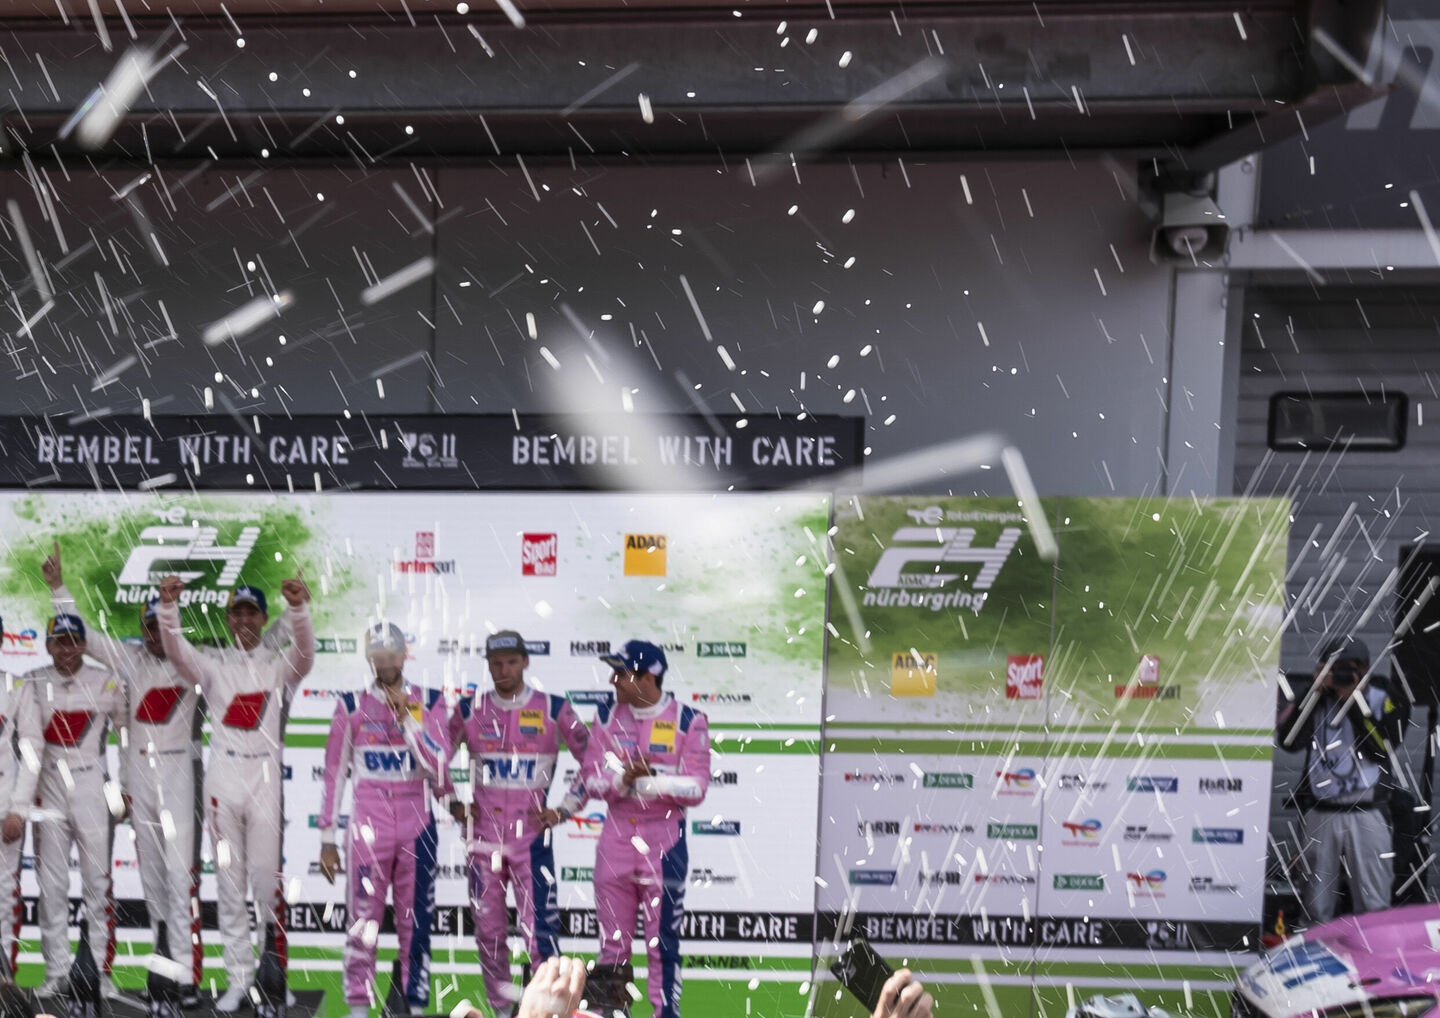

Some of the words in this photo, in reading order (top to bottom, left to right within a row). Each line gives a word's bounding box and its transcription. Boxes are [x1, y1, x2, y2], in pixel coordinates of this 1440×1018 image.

[38, 435, 160, 464] BEMBEL
[179, 435, 251, 464] WITH
[269, 435, 350, 465] CARE
[512, 435, 637, 465] BEMBEL
[660, 435, 733, 465] WITH
[751, 435, 836, 466] CARE
[626, 535, 666, 550] ADAC
[115, 586, 230, 608] nürbgring
[863, 588, 984, 611] nürburgring
[738, 916, 798, 940] CARE
[867, 916, 958, 942] BEMBEL
[972, 918, 1031, 943] WITH
[1042, 922, 1104, 944] CARE
[686, 954, 751, 970] 24hNBR
